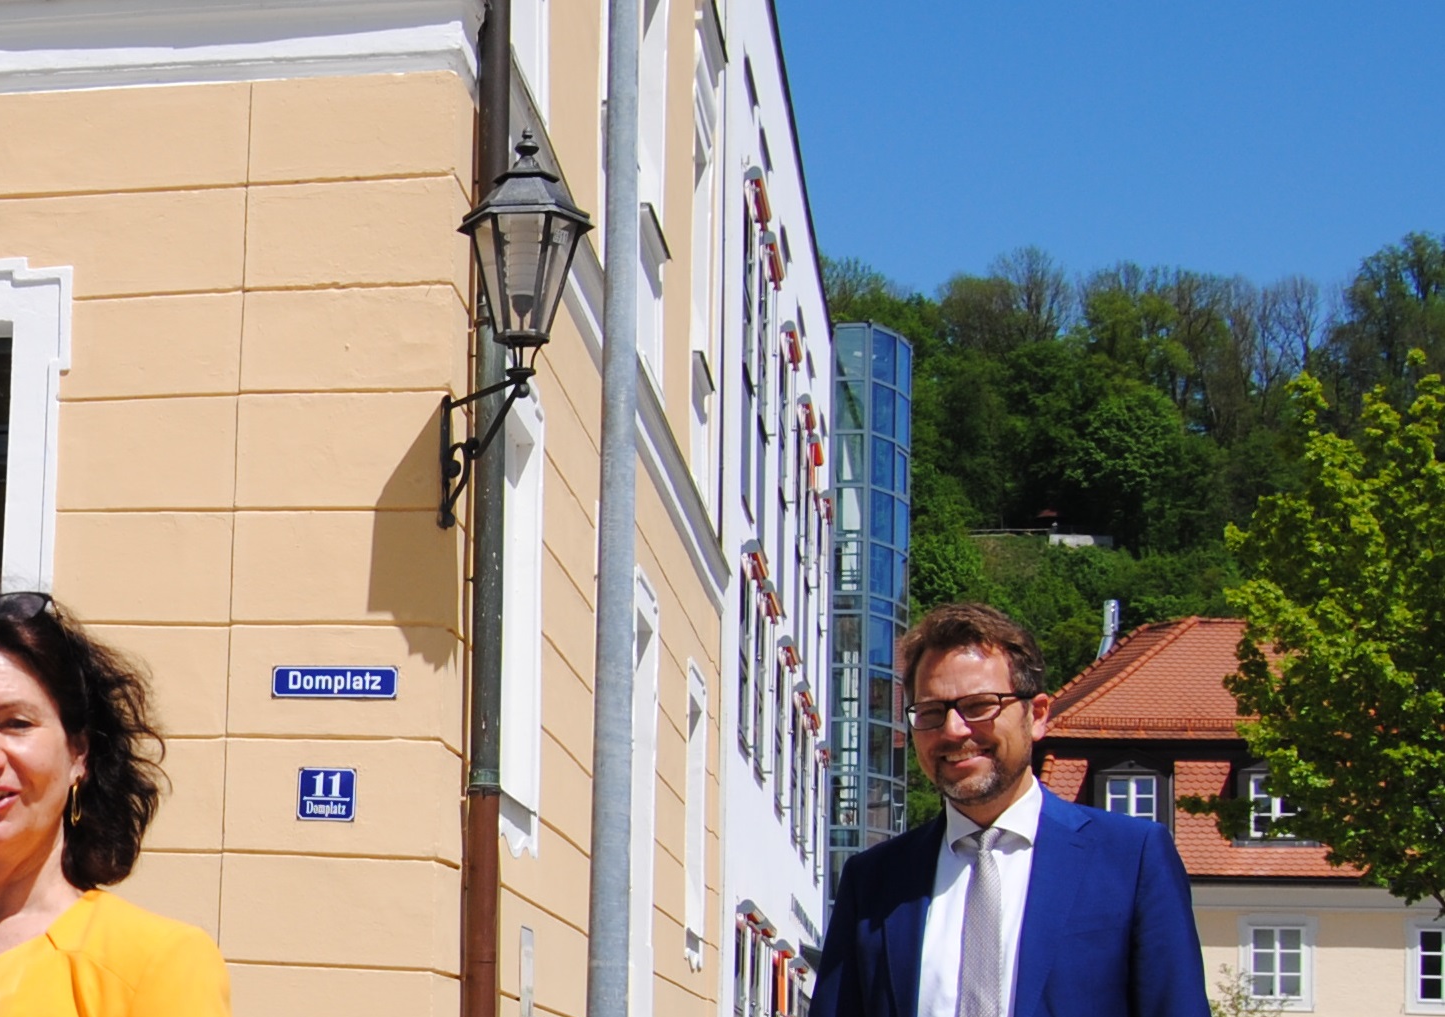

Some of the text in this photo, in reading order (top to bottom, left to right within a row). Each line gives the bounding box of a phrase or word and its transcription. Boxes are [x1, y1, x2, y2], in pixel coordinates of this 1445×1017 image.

[288, 671, 382, 694] Domplatz
[312, 771, 341, 798] 11
[306, 801, 346, 817] Domplatz
